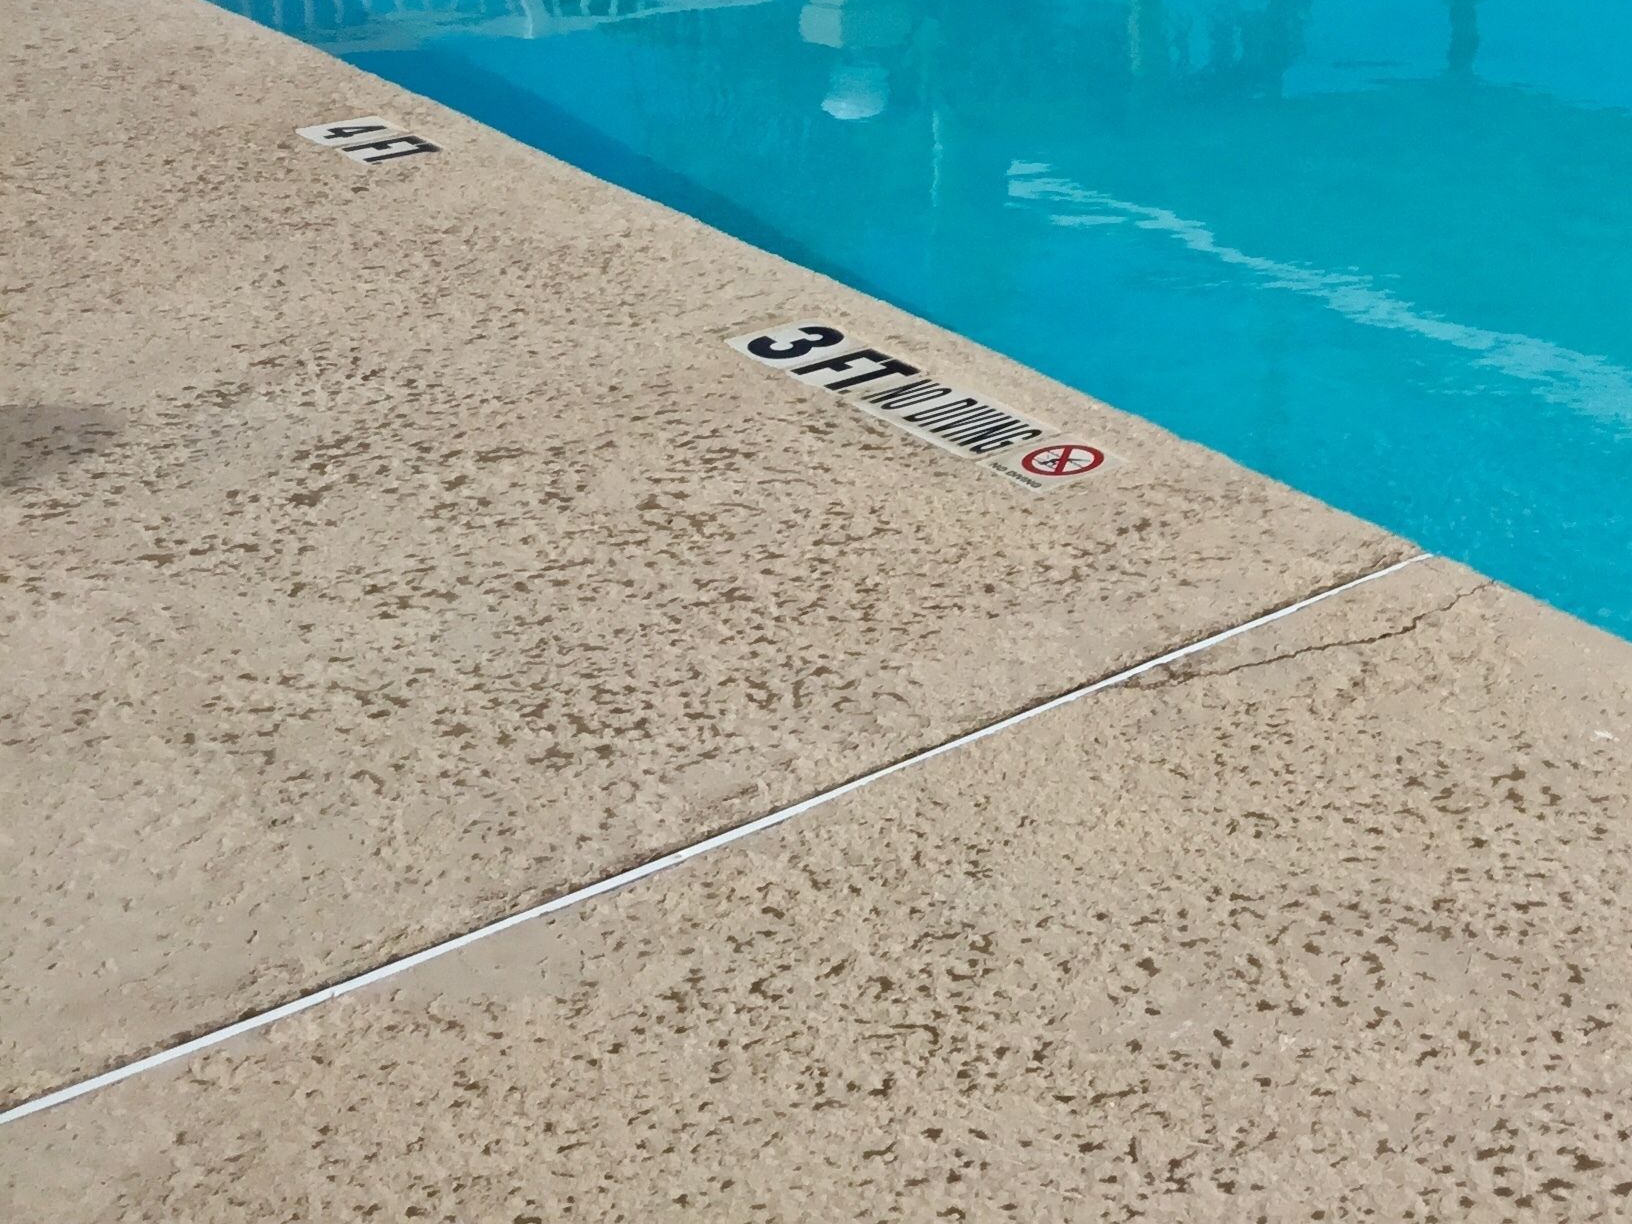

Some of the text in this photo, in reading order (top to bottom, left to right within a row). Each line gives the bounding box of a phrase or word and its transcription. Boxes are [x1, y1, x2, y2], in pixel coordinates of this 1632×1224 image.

[323, 125, 388, 140] 4
[747, 325, 845, 360] 3
[860, 378, 953, 410] NO
[902, 397, 1042, 455] DIVING
[990, 461, 1009, 472] NO
